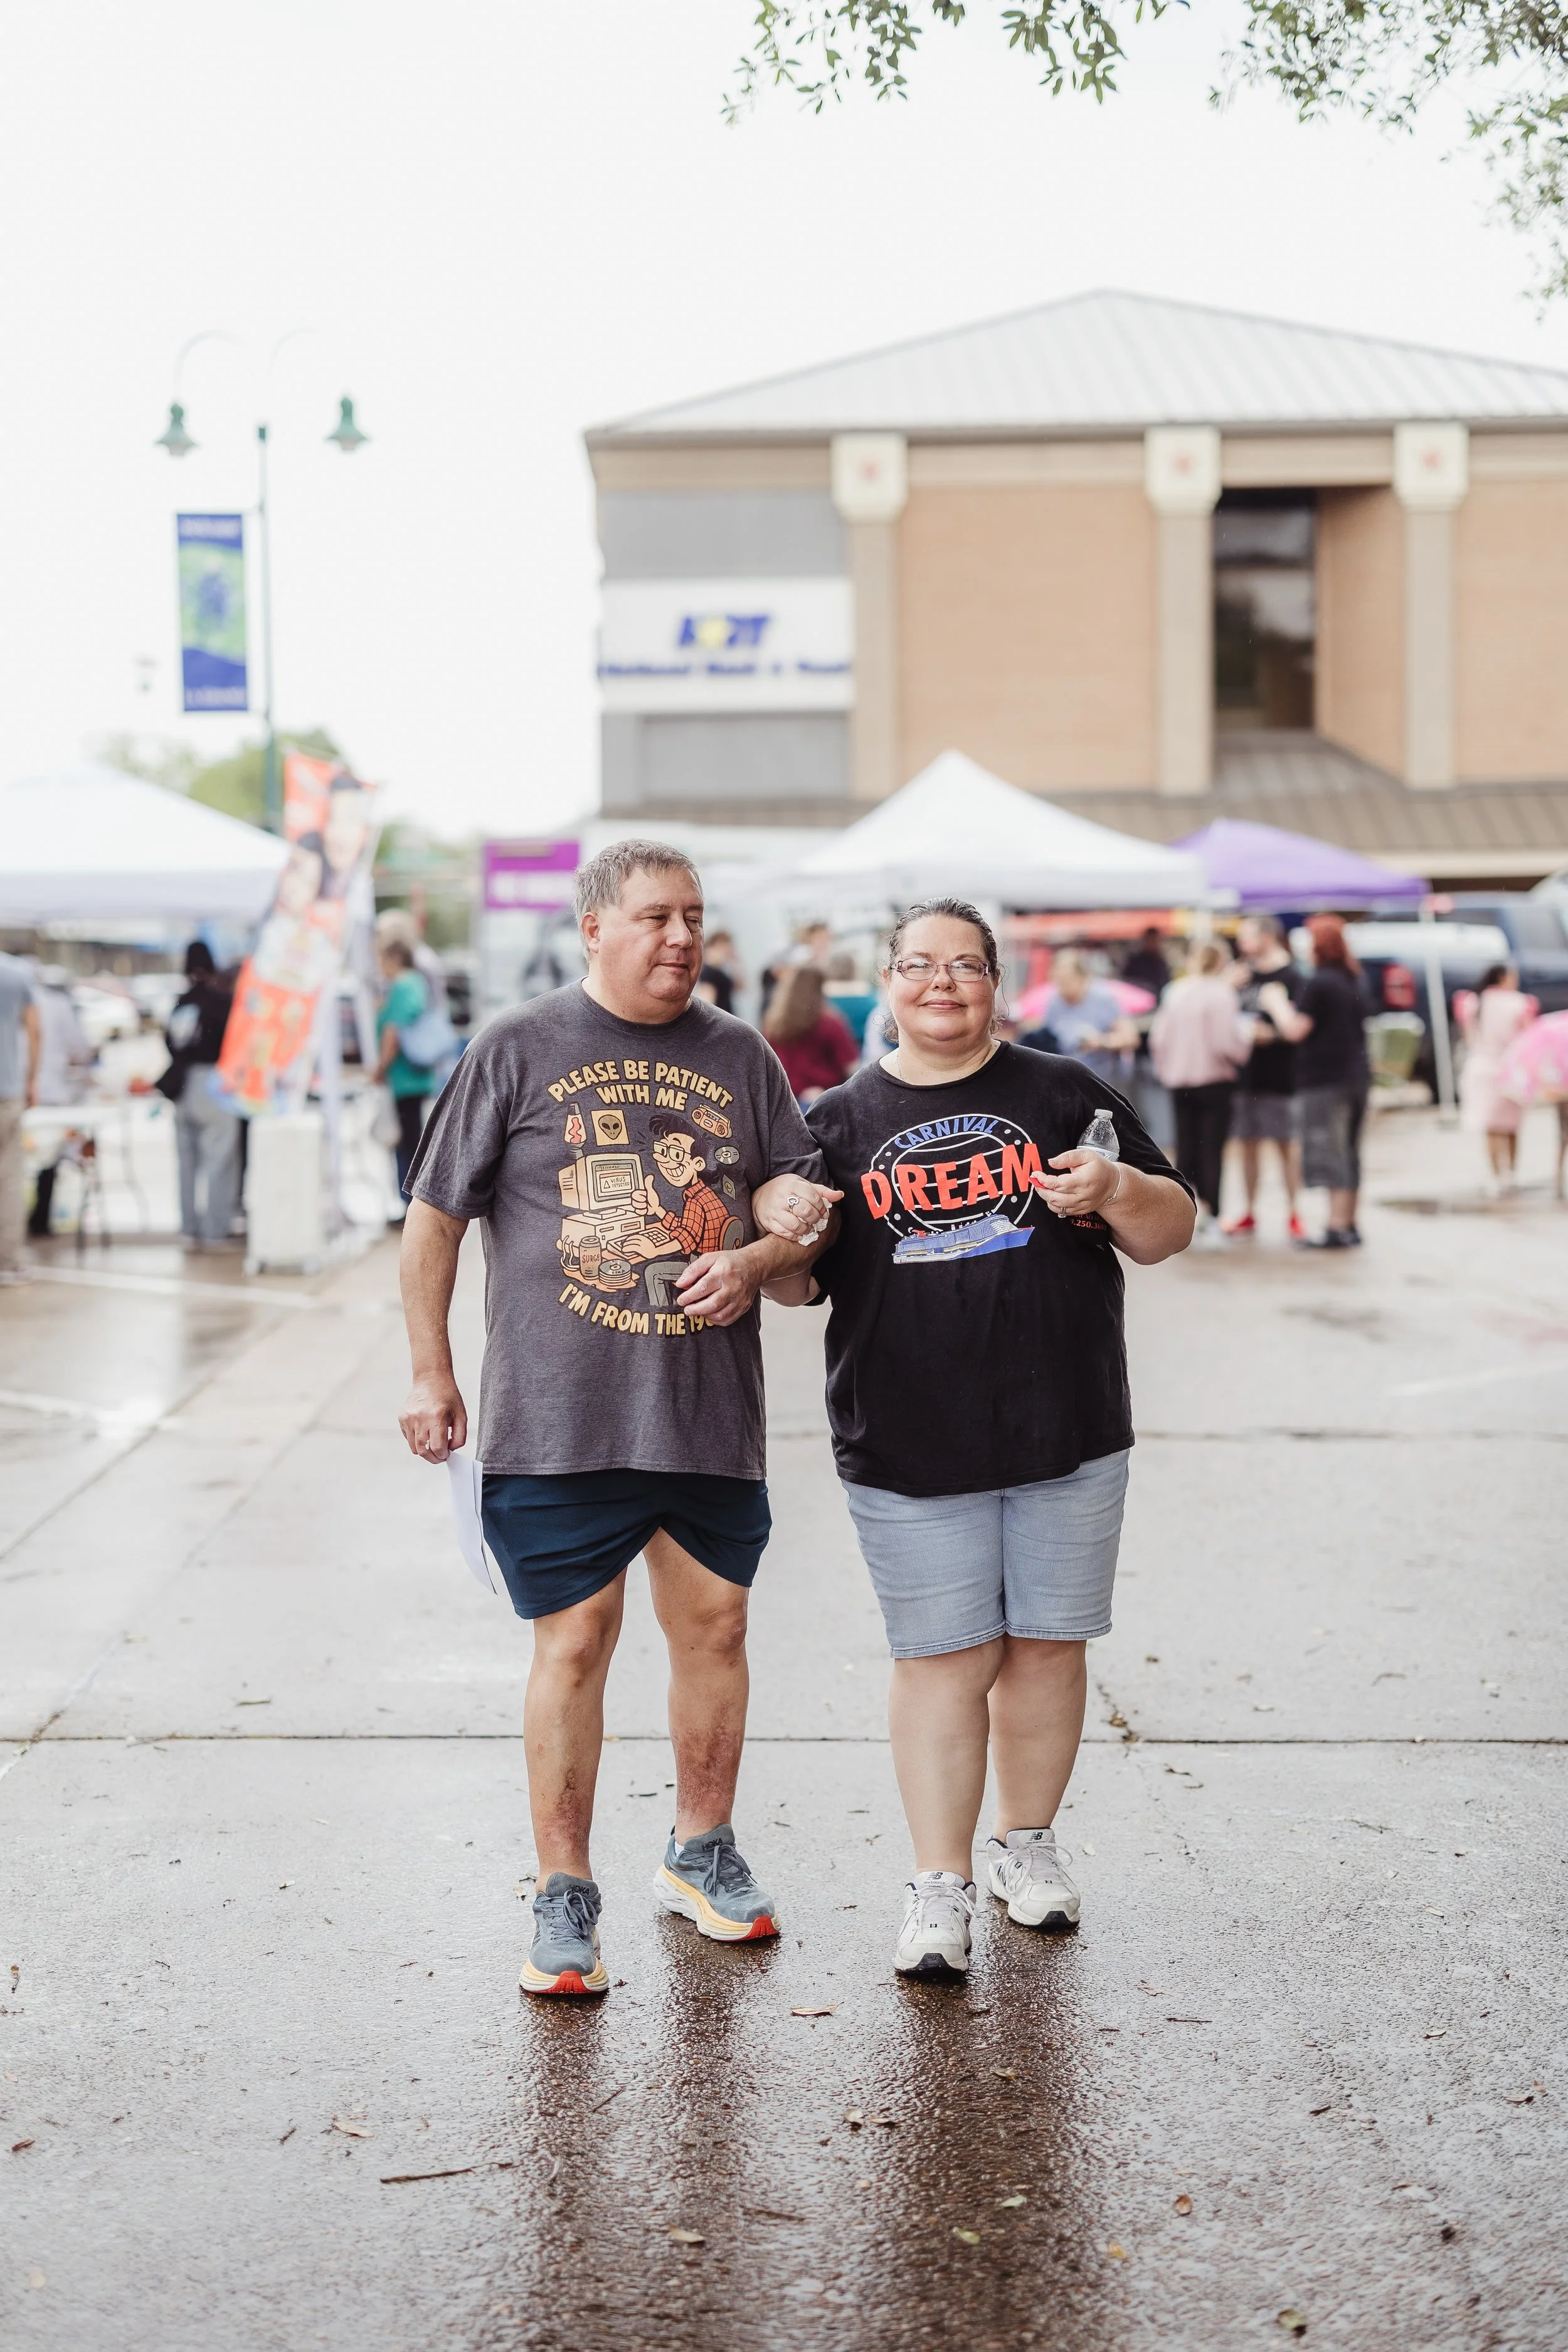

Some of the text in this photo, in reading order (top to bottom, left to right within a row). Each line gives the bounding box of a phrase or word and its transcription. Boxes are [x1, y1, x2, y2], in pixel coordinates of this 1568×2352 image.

[547, 1059, 734, 1108] PLEASE BE PATIENT
[596, 1084, 688, 1111] WITH ME
[894, 1116, 1000, 1149] CARNIVAL
[861, 1143, 1042, 1219] DREAM
[559, 1283, 591, 1316] I'M
[591, 1301, 649, 1335] FROM
[655, 1313, 686, 1335] THE
[702, 1837, 723, 1851] HOKA
